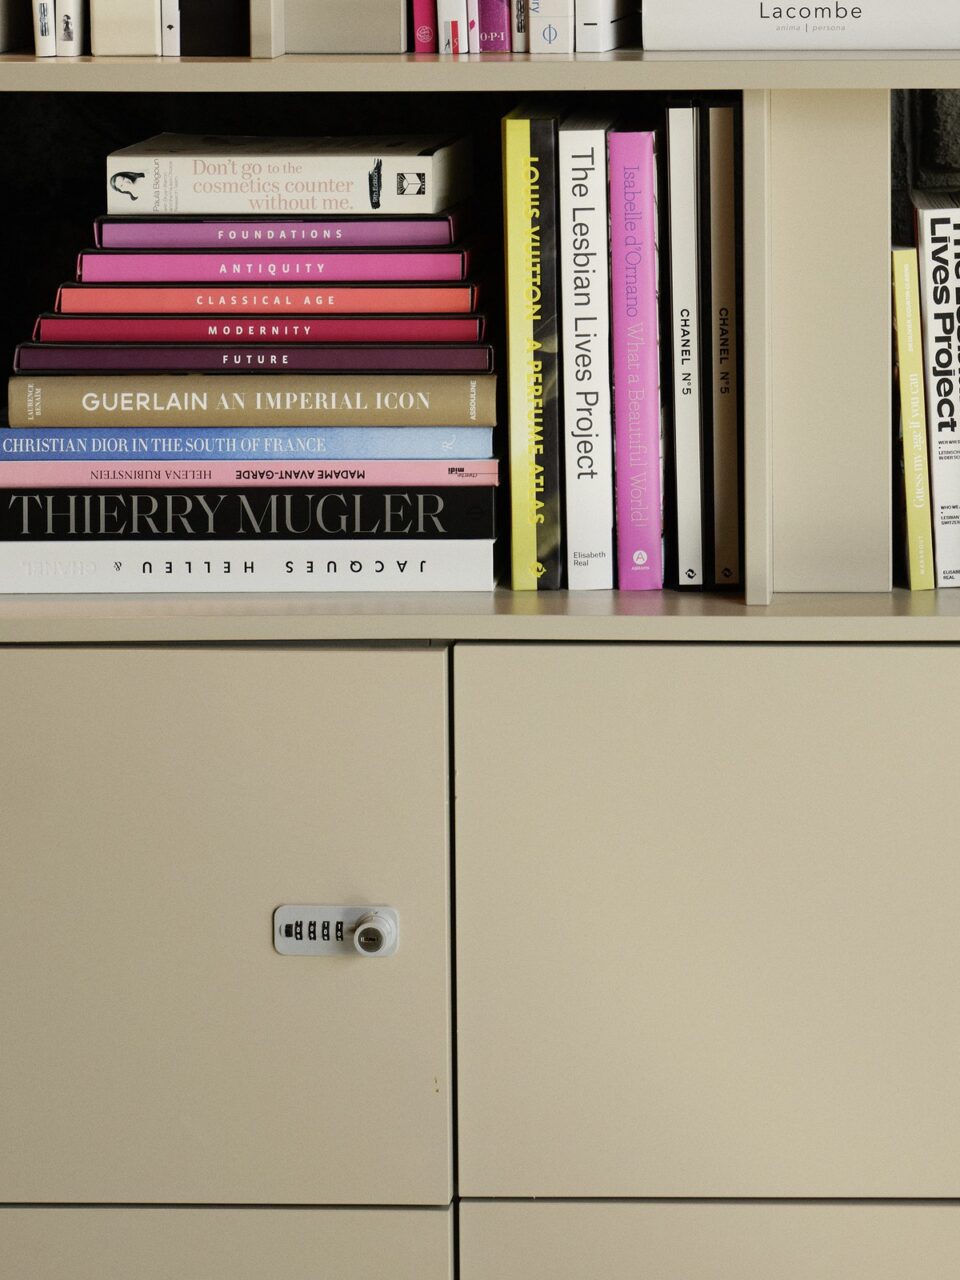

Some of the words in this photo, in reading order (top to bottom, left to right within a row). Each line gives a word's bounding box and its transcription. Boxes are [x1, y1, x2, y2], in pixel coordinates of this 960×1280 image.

[760, 1, 862, 19] Lacombe
[192, 159, 237, 175] Don't
[241, 163, 262, 179] go
[268, 163, 280, 174] to
[283, 162, 303, 174] the
[571, 146, 594, 197] The
[192, 177, 280, 194] cosmetics
[285, 180, 354, 194] counter
[522, 156, 540, 220] LOUIS
[248, 194, 318, 210] without
[322, 198, 354, 210] me.
[623, 165, 641, 231] Isabelle
[217, 229, 343, 240] FOUNDATIONS
[572, 207, 597, 306] Lesbian
[930, 217, 951, 305] Lives
[219, 263, 325, 276] ANTIQUITY
[524, 226, 542, 320] VUITTON
[624, 233, 642, 318] d'Ornano
[196, 295, 292, 306] CLASSICAL
[303, 295, 335, 306] AGE
[208, 326, 312, 335] MODERNITY
[680, 308, 691, 365] CHANEL
[719, 307, 729, 365] CHANEL
[526, 338, 543, 353] A
[574, 316, 598, 382] Lives
[625, 322, 646, 370] What
[222, 355, 289, 364] FUTURE
[628, 375, 639, 384] a
[932, 312, 957, 432] Project
[82, 392, 208, 411] GUERLAIN
[215, 393, 245, 410] AN
[255, 392, 368, 410] IMPERIAL
[376, 392, 431, 410] ICON
[469, 379, 477, 420] ASSOULINE
[527, 360, 544, 455] PERFUME
[571, 390, 600, 480] Project
[628, 389, 648, 467] Beautiful
[3, 438, 87, 453] CHRISTIAN
[92, 438, 128, 453] DIOR
[132, 438, 148, 453] IN
[151, 438, 182, 452] THE
[186, 438, 236, 452] SOUTH
[240, 438, 261, 452] OF
[264, 437, 326, 452] FRANCE
[90, 470, 161, 480] RUBINSTEIN
[165, 470, 212, 480] HELENA
[235, 470, 314, 480] AVANT-GARDE
[318, 470, 365, 479] MADAME
[528, 466, 545, 525] ATLAS
[8, 493, 228, 535] THIERRY
[236, 493, 448, 535] MUGLER
[573, 551, 606, 559] Elisabeth
[573, 559, 589, 567] Real
[113, 561, 122, 571] &
[142, 561, 254, 574] HELLEU
[286, 560, 427, 573] JACQUES
